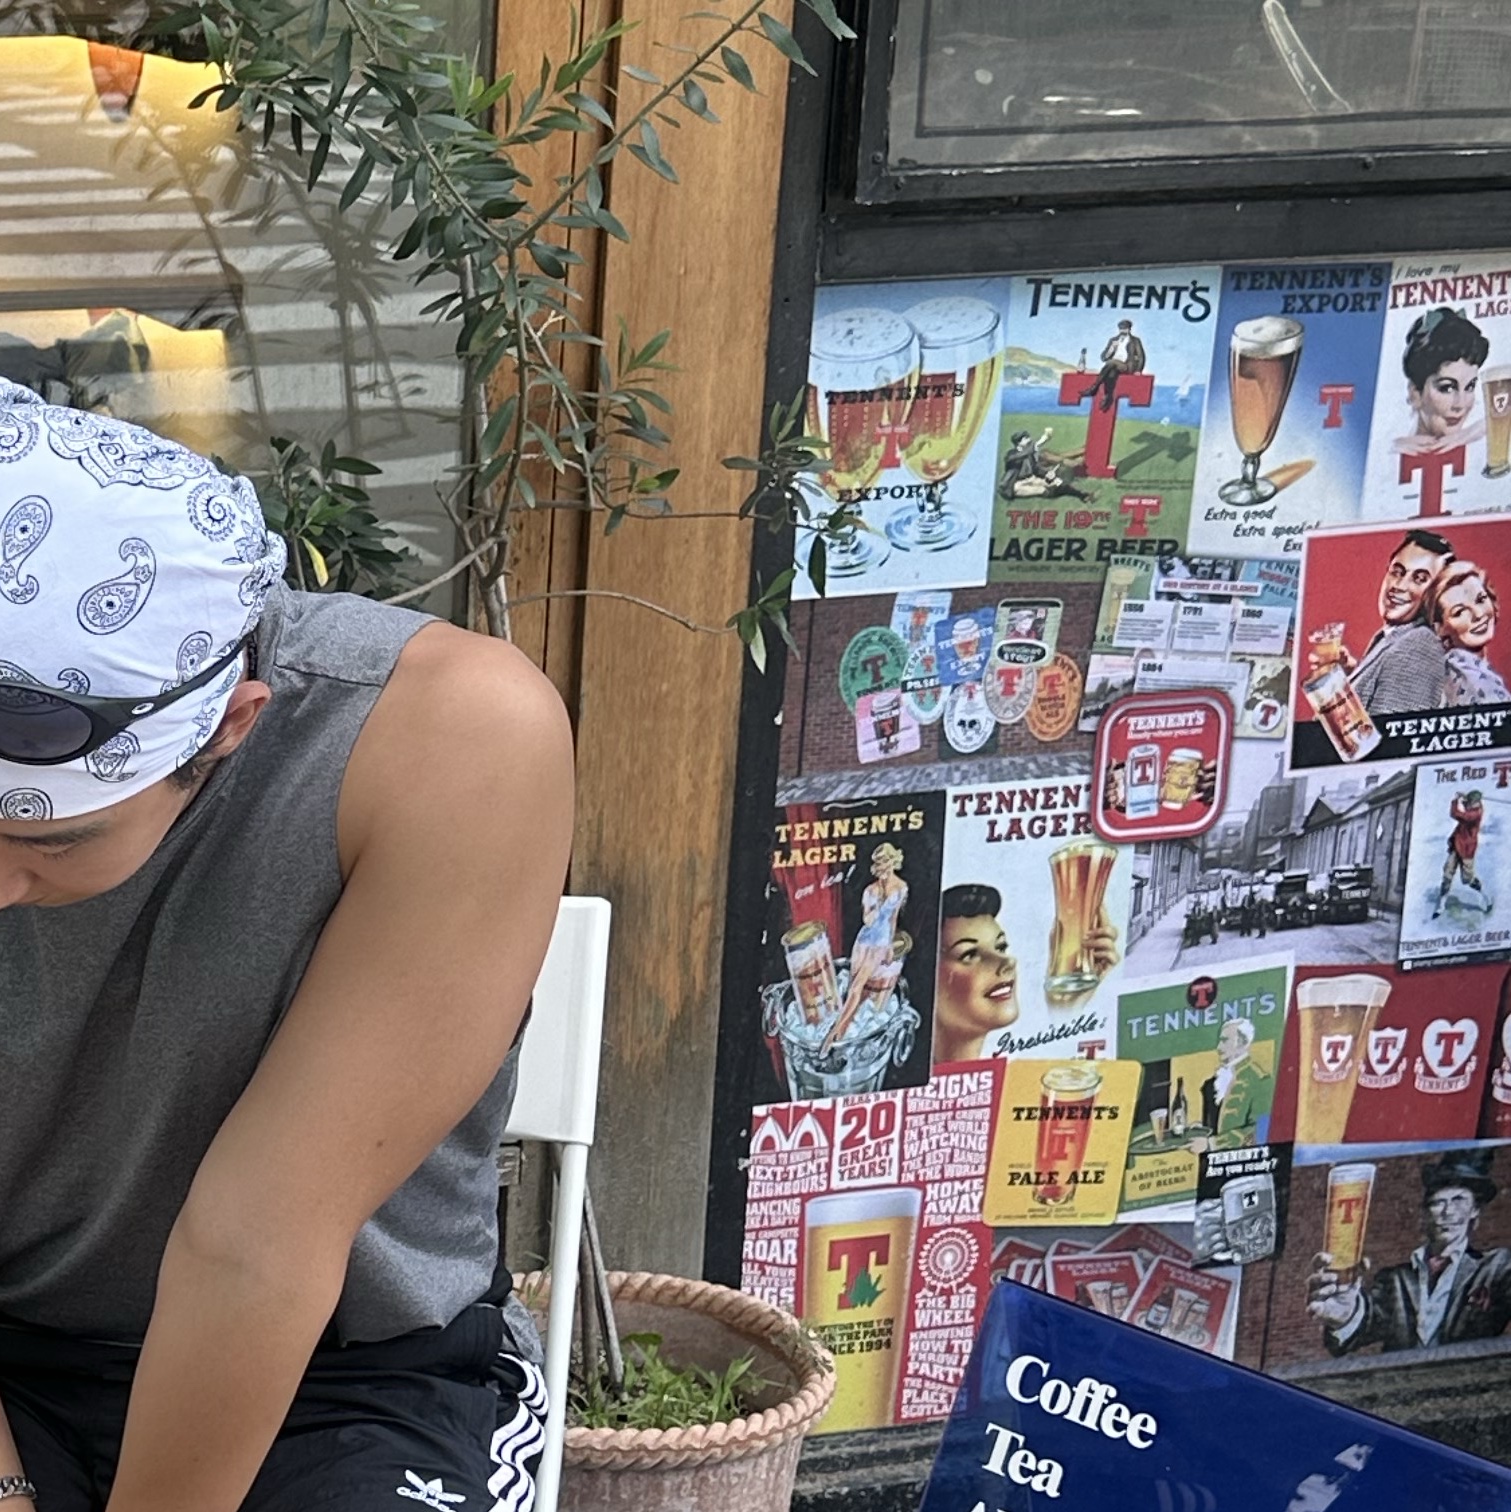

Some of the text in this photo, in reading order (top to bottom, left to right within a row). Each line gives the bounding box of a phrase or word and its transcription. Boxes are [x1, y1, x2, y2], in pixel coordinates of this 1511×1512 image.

[1231, 267, 1383, 292] TENNENT'S
[1405, 266, 1433, 278] love
[1439, 264, 1461, 274] my
[1026, 278, 1211, 322] TENNENT'S
[1281, 292, 1381, 314] EXPORT
[838, 484, 948, 503] EXPORT
[1007, 510, 1058, 530] THE
[1205, 505, 1277, 523] Extra good
[1233, 524, 1265, 537] Extra
[989, 538, 1087, 562] LAGER
[1128, 711, 1206, 730] TENNENT'S
[1410, 732, 1494, 753] LAGER
[774, 805, 924, 843] TENNENT'S
[986, 812, 1091, 843] LAGER
[773, 844, 856, 868] LAGER
[1127, 987, 1276, 1039] TENNENT'S
[1435, 1032, 1465, 1067] T
[1012, 1105, 1119, 1121] TENNENT'S
[841, 1101, 896, 1151] 20
[838, 1138, 895, 1168] GREAT
[904, 1133, 988, 1160] WATCHING
[838, 1158, 893, 1182] YEARS!
[1007, 1169, 1106, 1186] PALE ALE
[925, 1178, 984, 1202] HOME
[924, 1191, 984, 1214] AWAY
[743, 1240, 798, 1265] ROAR
[915, 1293, 976, 1309] THE BIG
[914, 1308, 975, 1329] WHEEL
[910, 1324, 975, 1341] KNOWING
[857, 1337, 892, 1354] 1994
[909, 1338, 973, 1354] HOW TO
[908, 1352, 960, 1366] THROW
[1005, 1356, 1157, 1449] Coffee
[981, 1423, 1063, 1498] Tea
